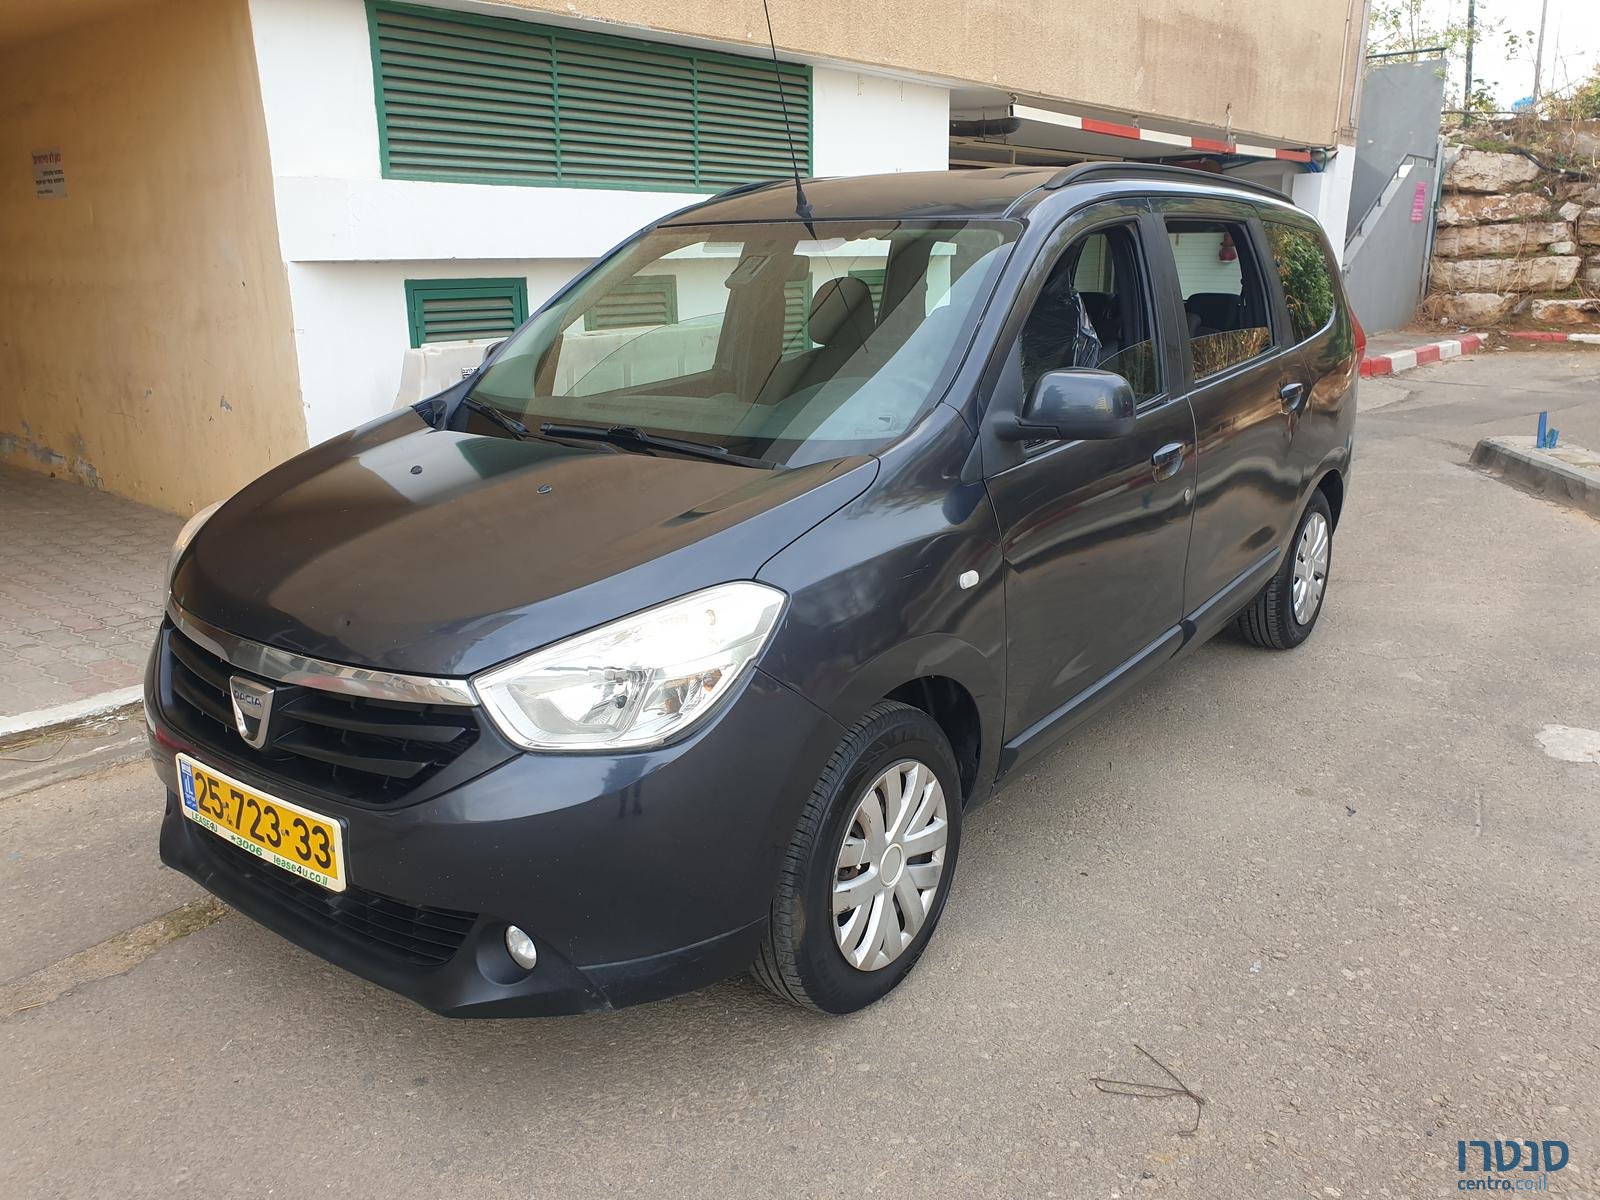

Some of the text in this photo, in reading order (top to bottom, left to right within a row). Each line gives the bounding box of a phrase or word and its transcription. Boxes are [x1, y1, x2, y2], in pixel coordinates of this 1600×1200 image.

[233, 690, 262, 706] DACIA
[191, 811, 218, 833] LEASE4U
[273, 854, 328, 886] lease4u.co.il
